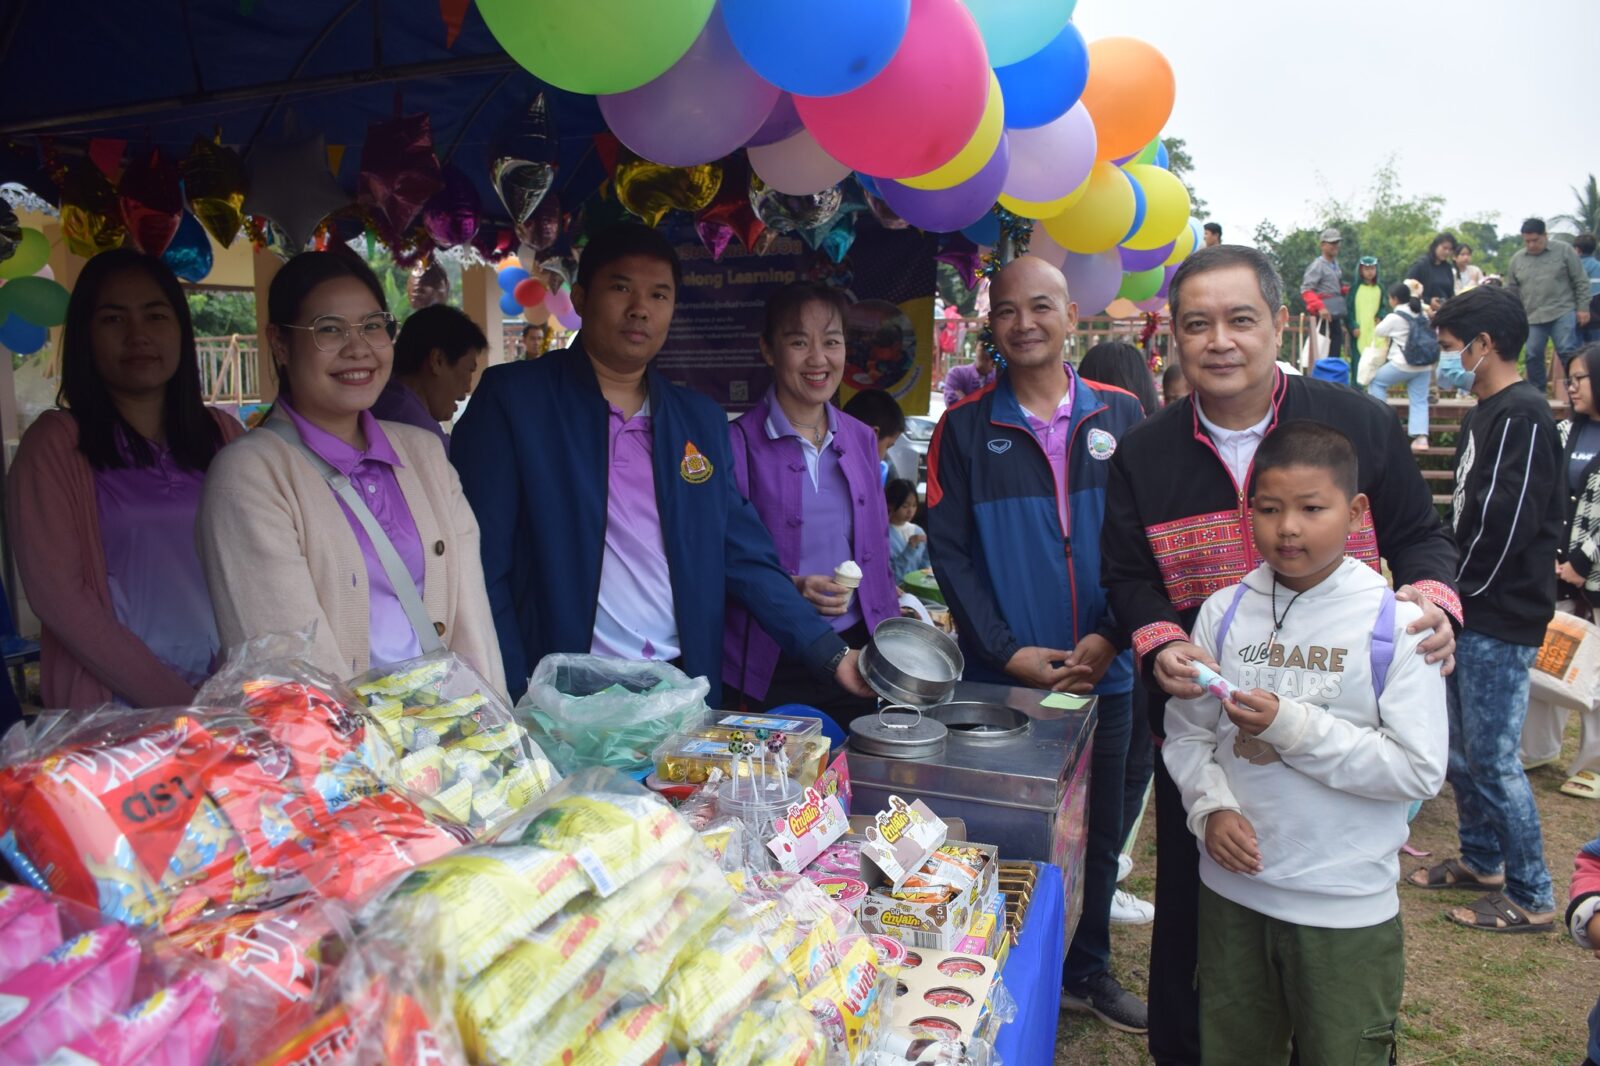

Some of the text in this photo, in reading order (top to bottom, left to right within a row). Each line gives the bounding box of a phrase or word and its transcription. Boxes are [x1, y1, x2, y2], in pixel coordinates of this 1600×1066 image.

[681, 267, 796, 289] elong Learning
[1239, 642, 1348, 672] We BARE
[1238, 665, 1343, 699] BEARS
